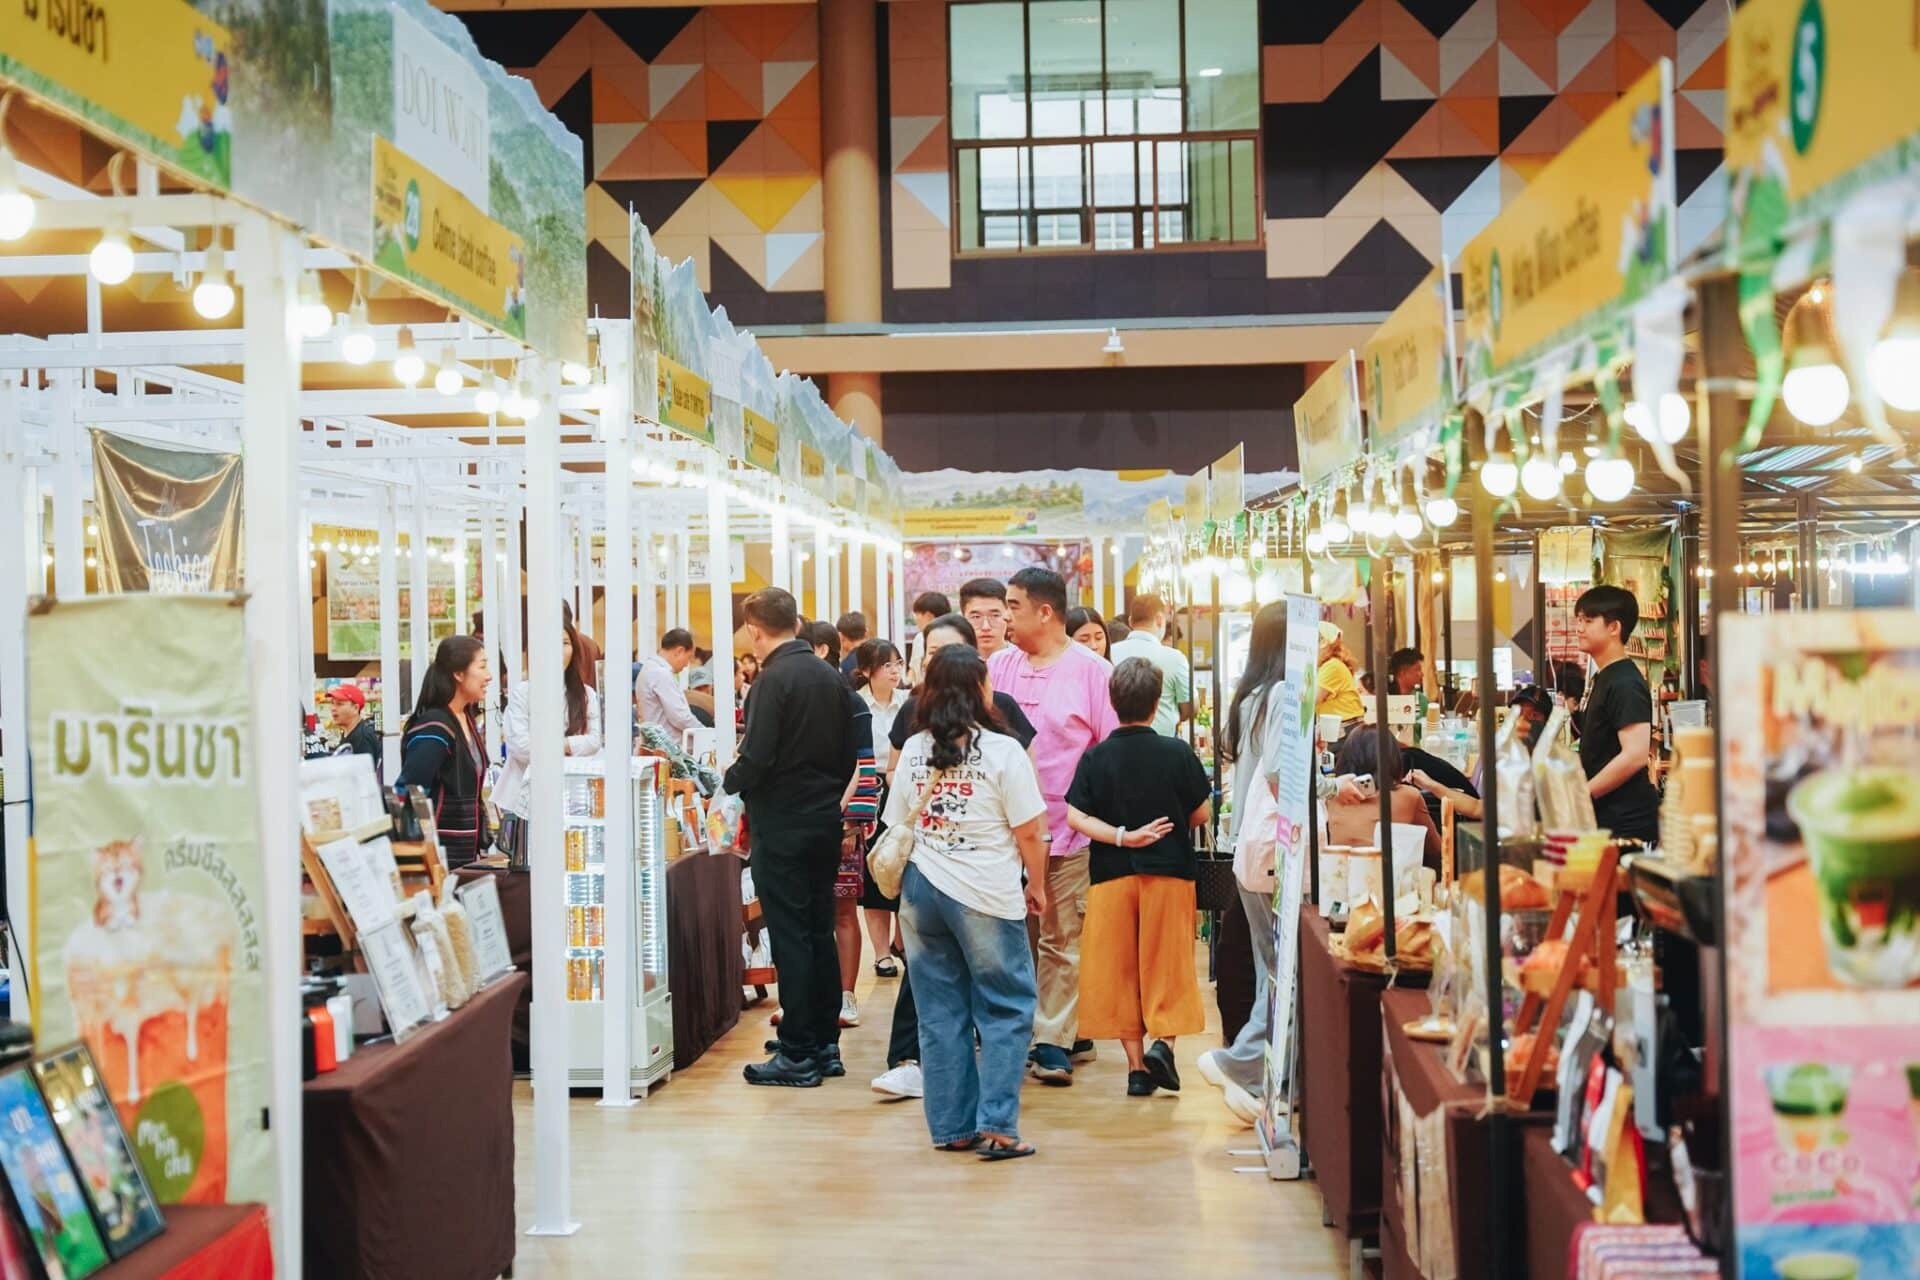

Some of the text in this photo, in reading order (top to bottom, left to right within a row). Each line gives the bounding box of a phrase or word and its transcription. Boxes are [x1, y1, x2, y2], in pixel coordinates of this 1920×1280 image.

[402, 53, 437, 134] DOI
[54, 705, 242, 780] มารินชา
